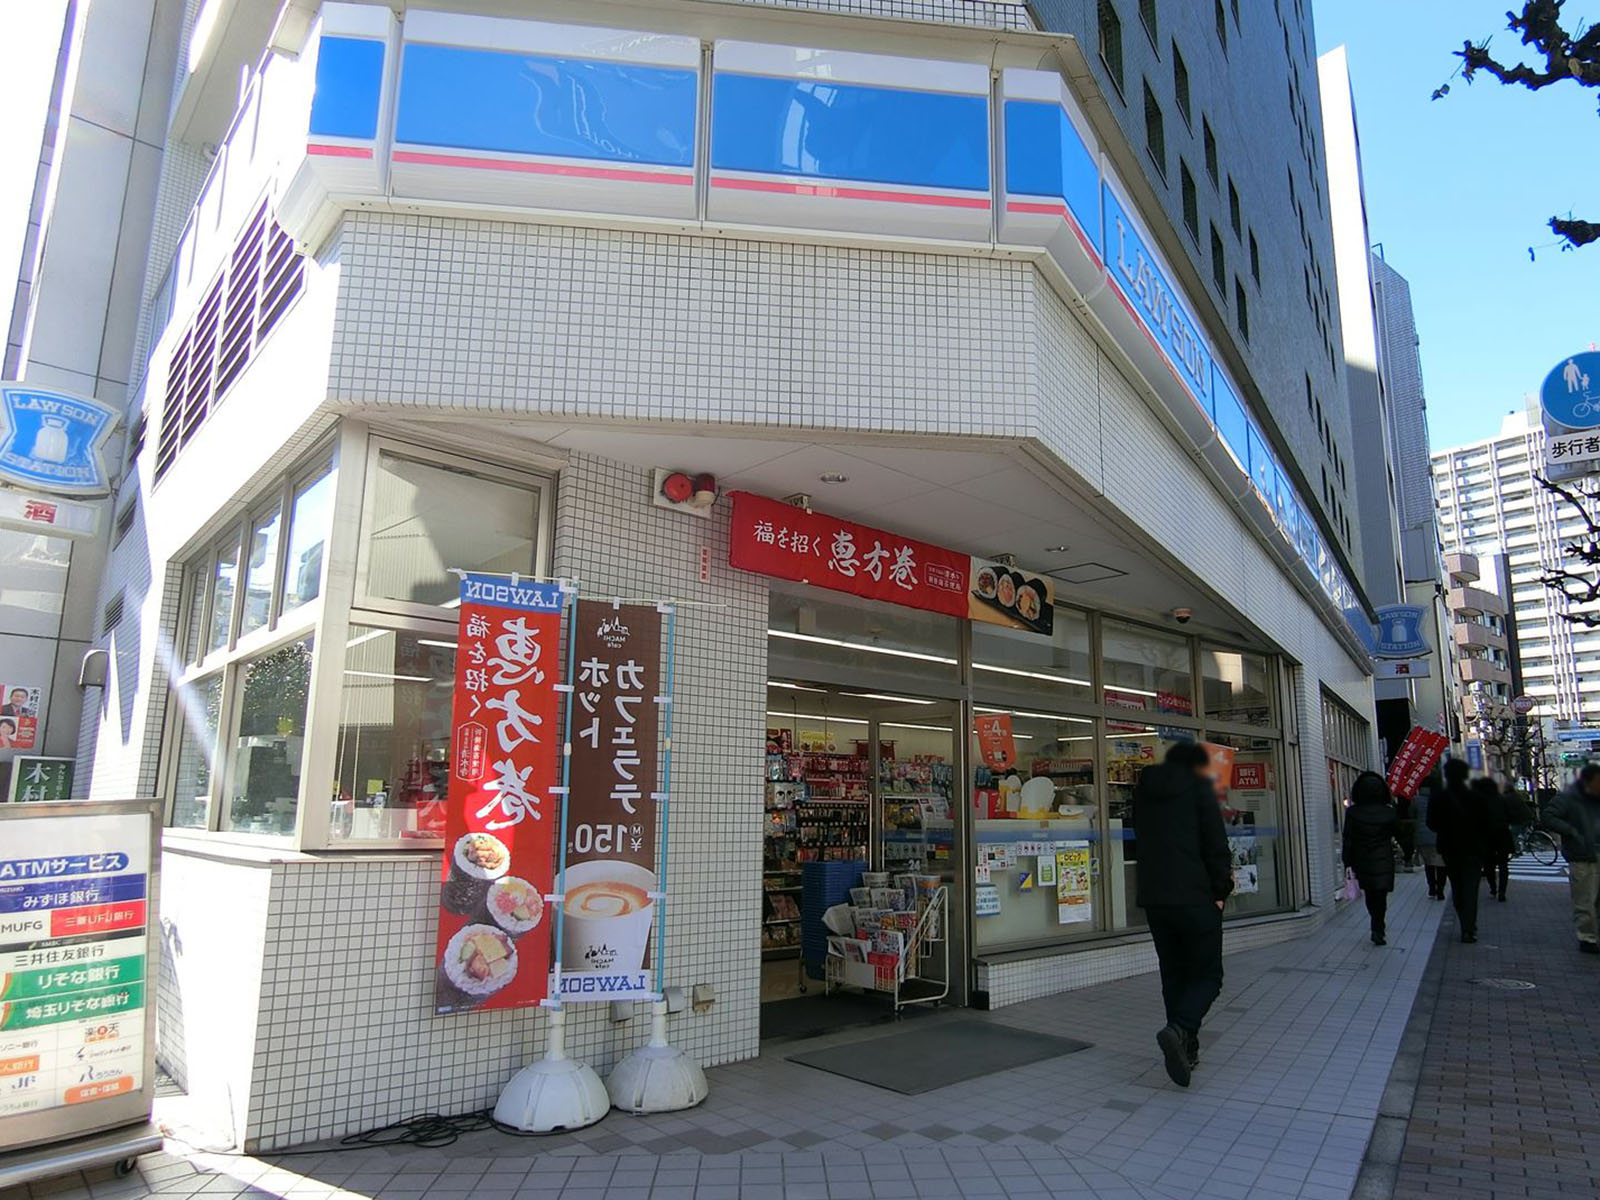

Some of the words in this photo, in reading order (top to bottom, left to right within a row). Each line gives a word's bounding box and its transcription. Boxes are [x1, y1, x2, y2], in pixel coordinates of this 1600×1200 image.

[1115, 217, 1207, 398] LAWSON
[13, 396, 98, 424] LAWSON
[1552, 436, 1600, 459] 歩行者
[5, 453, 91, 478] STATION
[24, 500, 58, 524] 酒
[753, 519, 821, 557] 福を招く
[828, 529, 919, 591] 恵方巻
[1, 854, 122, 877] ATMサービス
[23, 889, 100, 908] みずほ銀行
[1, 920, 43, 934] MUFG
[15, 944, 105, 967] 三井住友銀行
[38, 965, 119, 989] りそな銀行
[26, 991, 130, 1019] 埼玉りそな銀行
